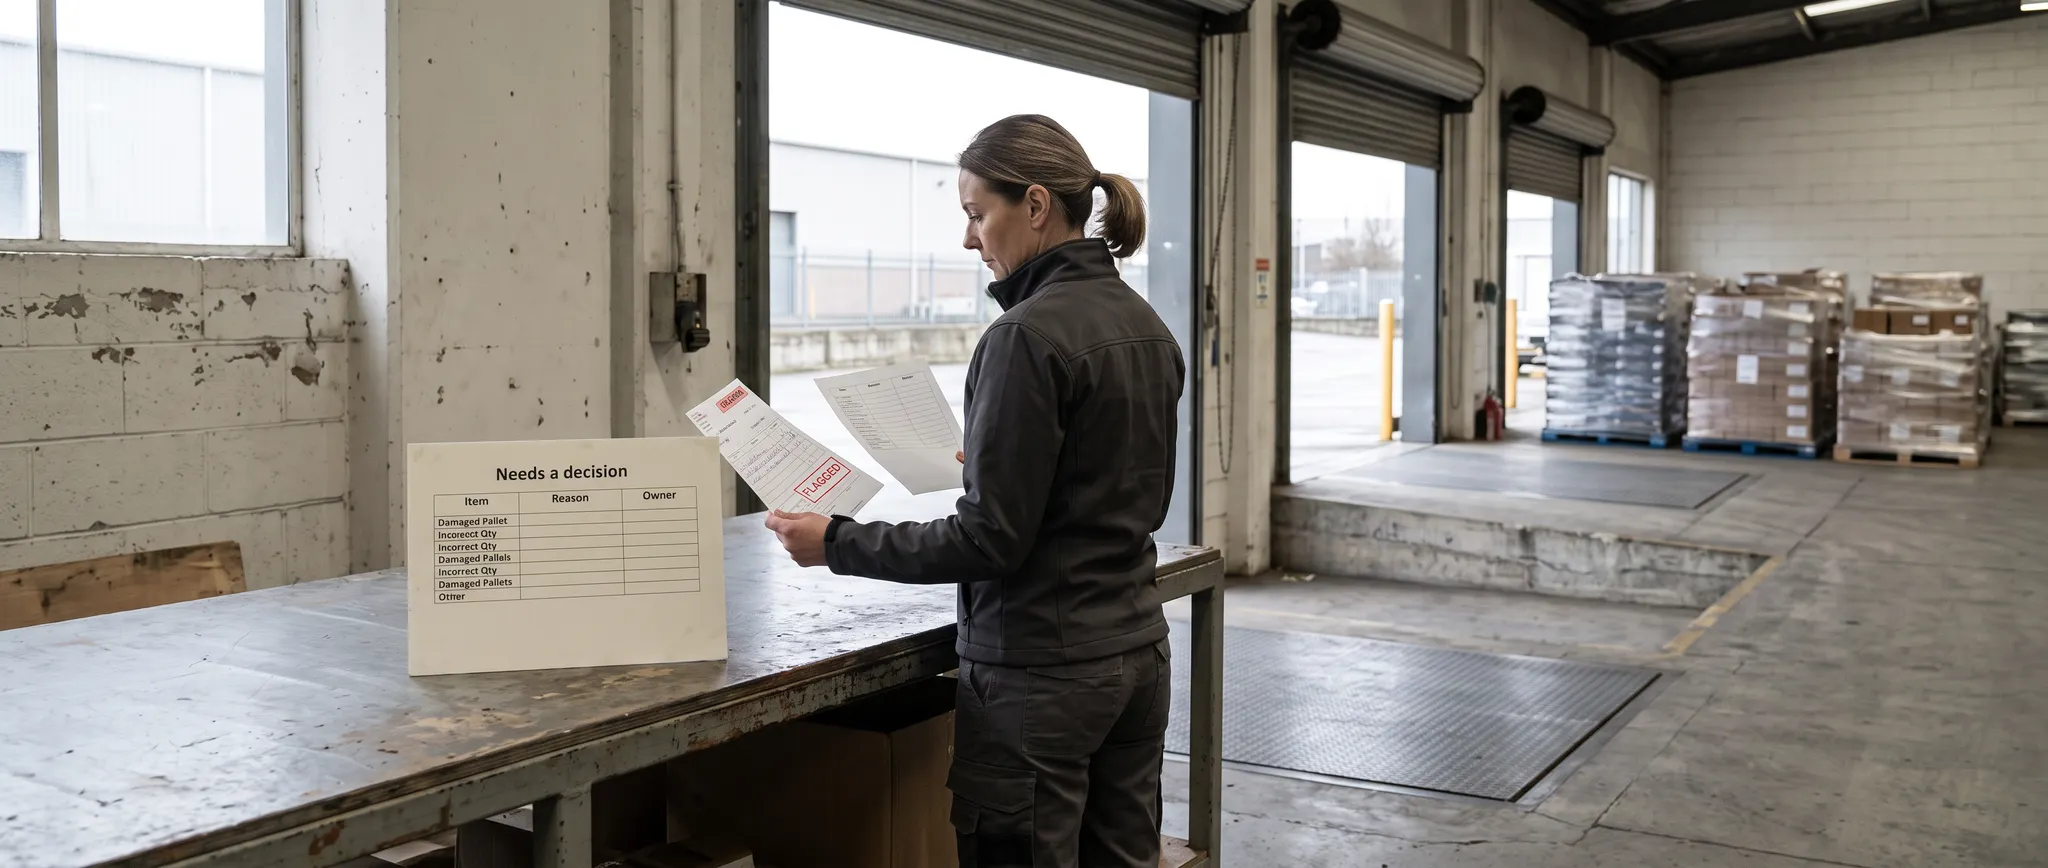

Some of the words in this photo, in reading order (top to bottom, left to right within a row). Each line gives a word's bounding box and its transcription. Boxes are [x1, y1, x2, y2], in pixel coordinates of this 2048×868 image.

[496, 467, 545, 480] Needs
[549, 470, 558, 479] a
[563, 465, 627, 478] decision
[802, 463, 841, 496] FLAGGED
[552, 494, 588, 502] Reason
[642, 491, 676, 500] Owner
[464, 497, 488, 505] Item
[438, 518, 479, 528] Damaged
[482, 517, 507, 525] Pallet
[480, 530, 496, 540] Qty
[438, 544, 478, 553] Incorrect
[480, 542, 496, 551] Qty
[438, 555, 480, 564] Damaged
[438, 568, 478, 576] Incorrect
[480, 567, 497, 576] Qty
[438, 579, 480, 589] Damaged
